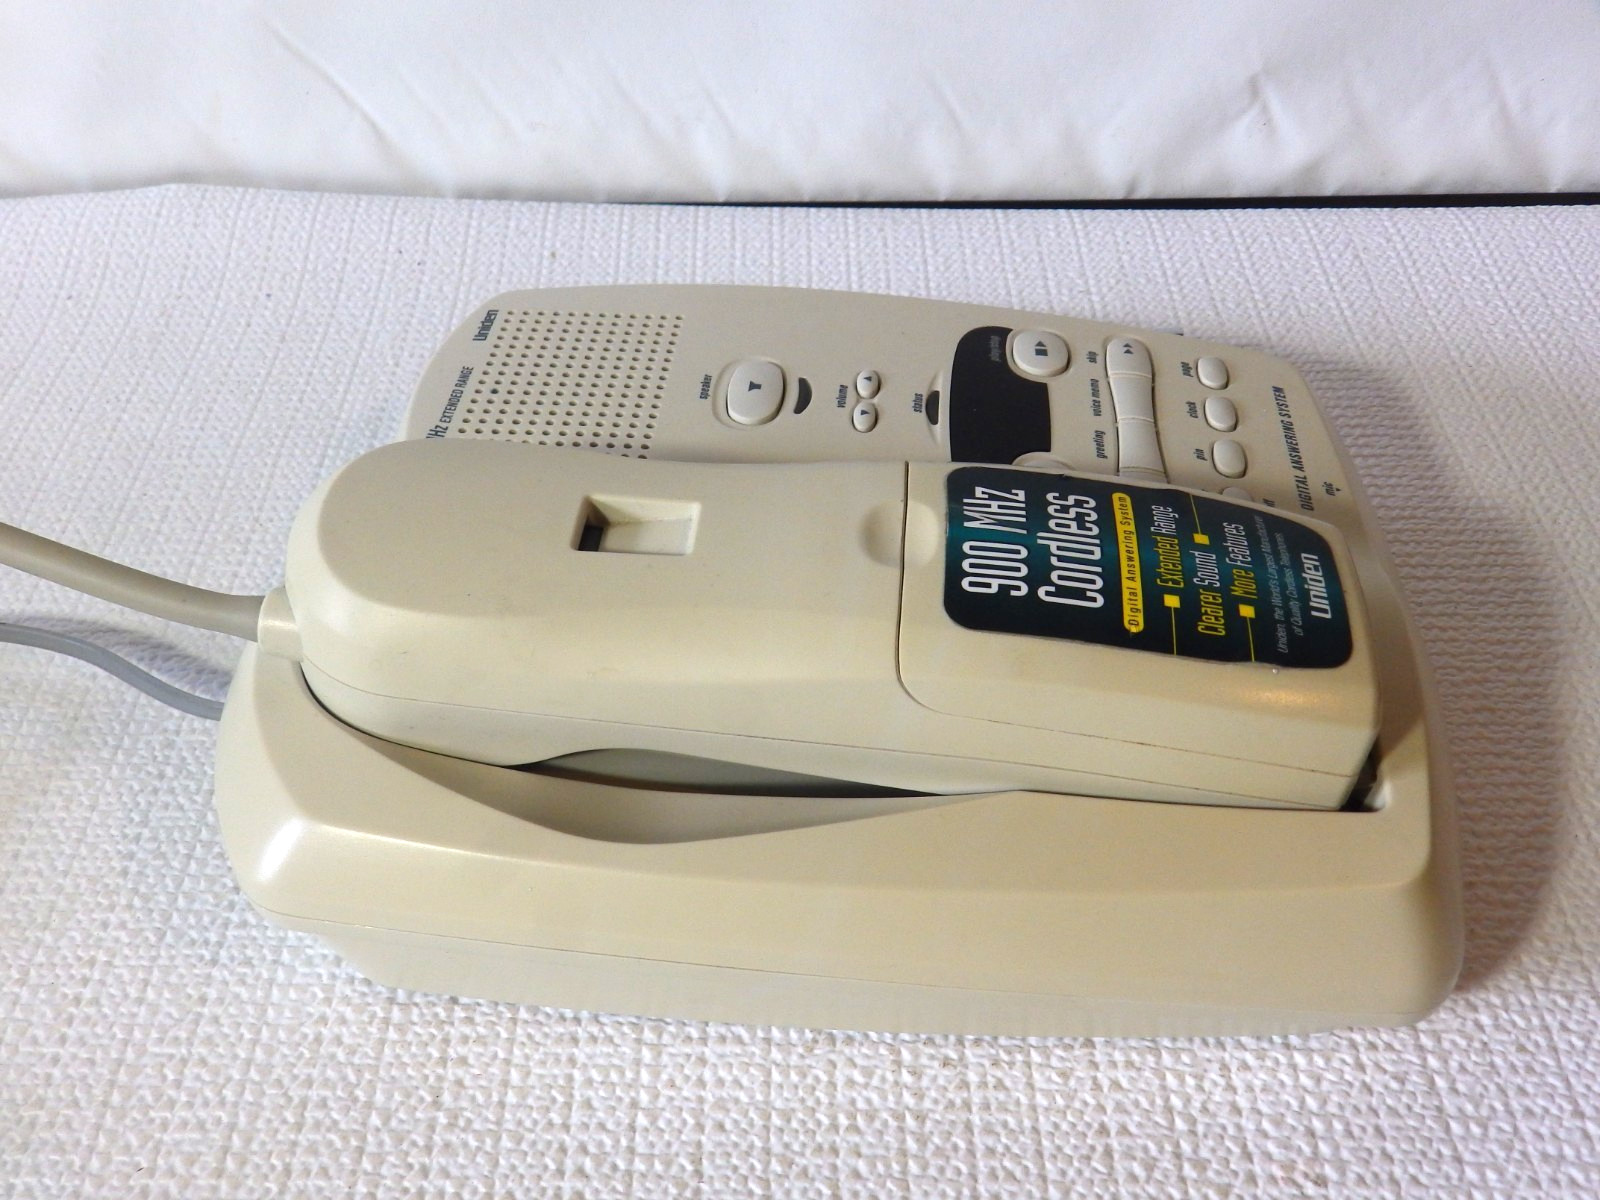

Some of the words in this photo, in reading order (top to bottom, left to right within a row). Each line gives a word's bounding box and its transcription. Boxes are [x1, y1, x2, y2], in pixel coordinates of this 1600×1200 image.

[473, 309, 499, 341] Uniden
[1086, 351, 1099, 364] skip
[1181, 361, 1194, 378] page
[699, 374, 713, 400] speaker
[836, 384, 849, 408] volume
[1090, 378, 1100, 398] memo
[426, 425, 448, 439] Hz
[440, 388, 464, 424] EXTENDED
[454, 366, 474, 388] RANGE
[912, 393, 924, 414] status
[1090, 399, 1102, 417] voice
[1186, 401, 1199, 418] clock
[1271, 386, 1292, 419] SYSTEM
[1092, 430, 1108, 459] greeting
[1193, 448, 1208, 461] pin
[1280, 420, 1305, 472] ANSWERING
[1292, 474, 1315, 511] DIGITAL
[1321, 481, 1336, 497] mic
[962, 486, 1028, 534] MHz
[1118, 496, 1133, 526] System
[1150, 505, 1179, 535] Range
[1222, 522, 1253, 567] Features
[1254, 515, 1272, 553] Manufacturer
[1036, 492, 1105, 608] Cordless
[1122, 528, 1138, 582] Answering
[1152, 536, 1184, 588] Extended
[960, 540, 1029, 596] 900
[1189, 550, 1220, 587] Sound
[1262, 553, 1279, 579] Largest
[1230, 568, 1258, 599] More
[1268, 578, 1283, 606] World's
[1283, 567, 1298, 598] Cordless
[1300, 553, 1332, 619] Uniden
[1125, 586, 1142, 627] Digital
[1197, 586, 1226, 636] Clearer
[1273, 606, 1285, 620] the
[1288, 599, 1303, 626] Quality
[1293, 625, 1304, 636] of
